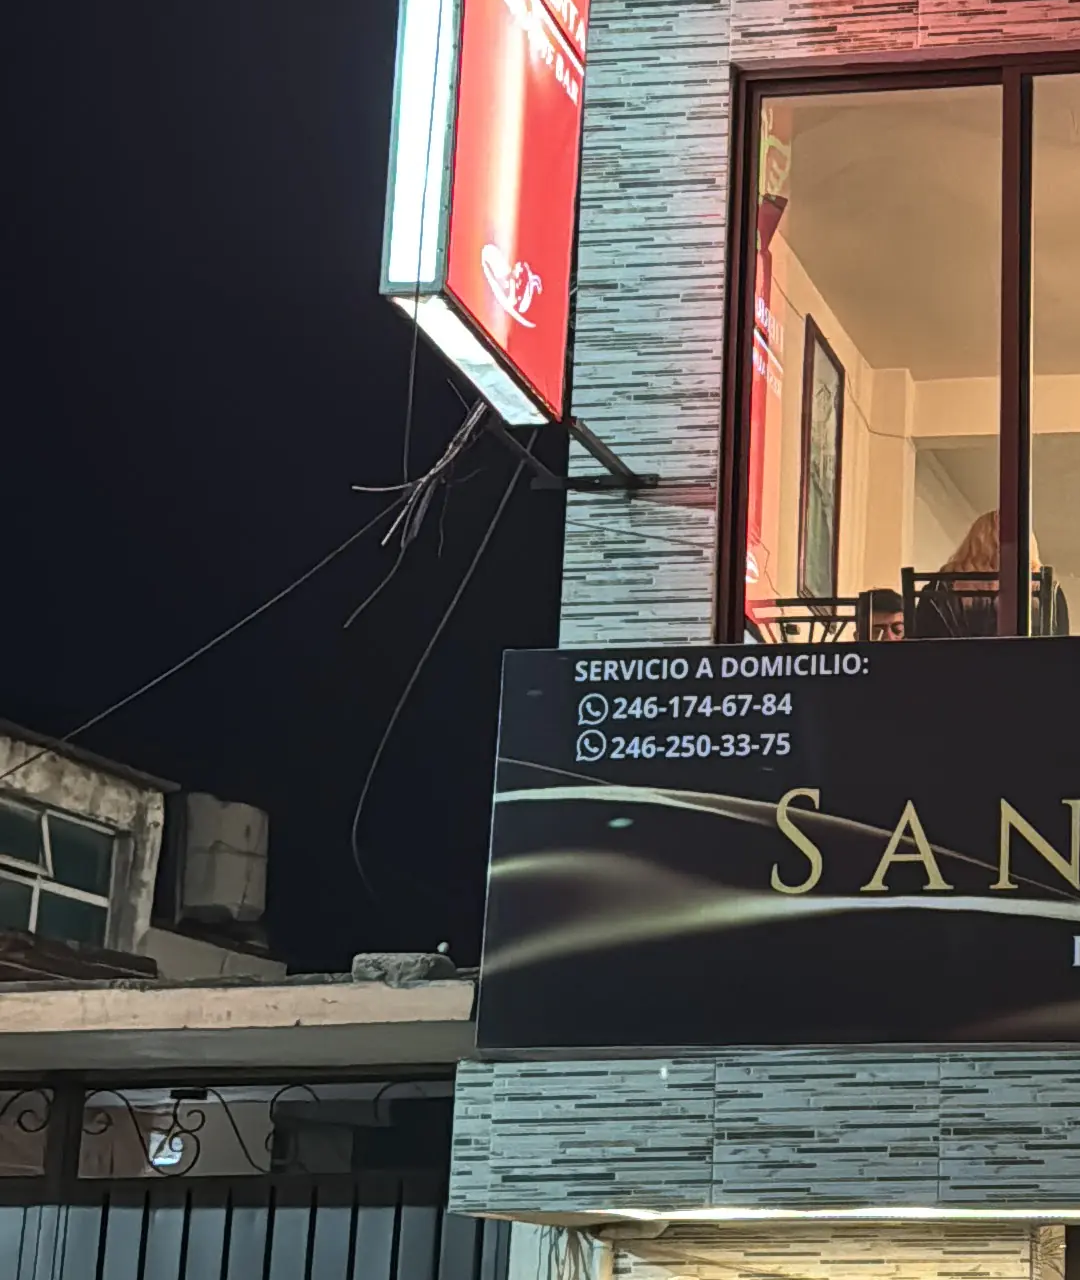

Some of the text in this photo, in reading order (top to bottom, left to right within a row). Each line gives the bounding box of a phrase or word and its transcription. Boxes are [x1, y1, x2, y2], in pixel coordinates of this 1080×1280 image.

[574, 653, 870, 682] SERVICIO A DOMICILIO:
[612, 693, 793, 720] 246-174-67-84
[610, 733, 791, 759] 246-250-33-75
